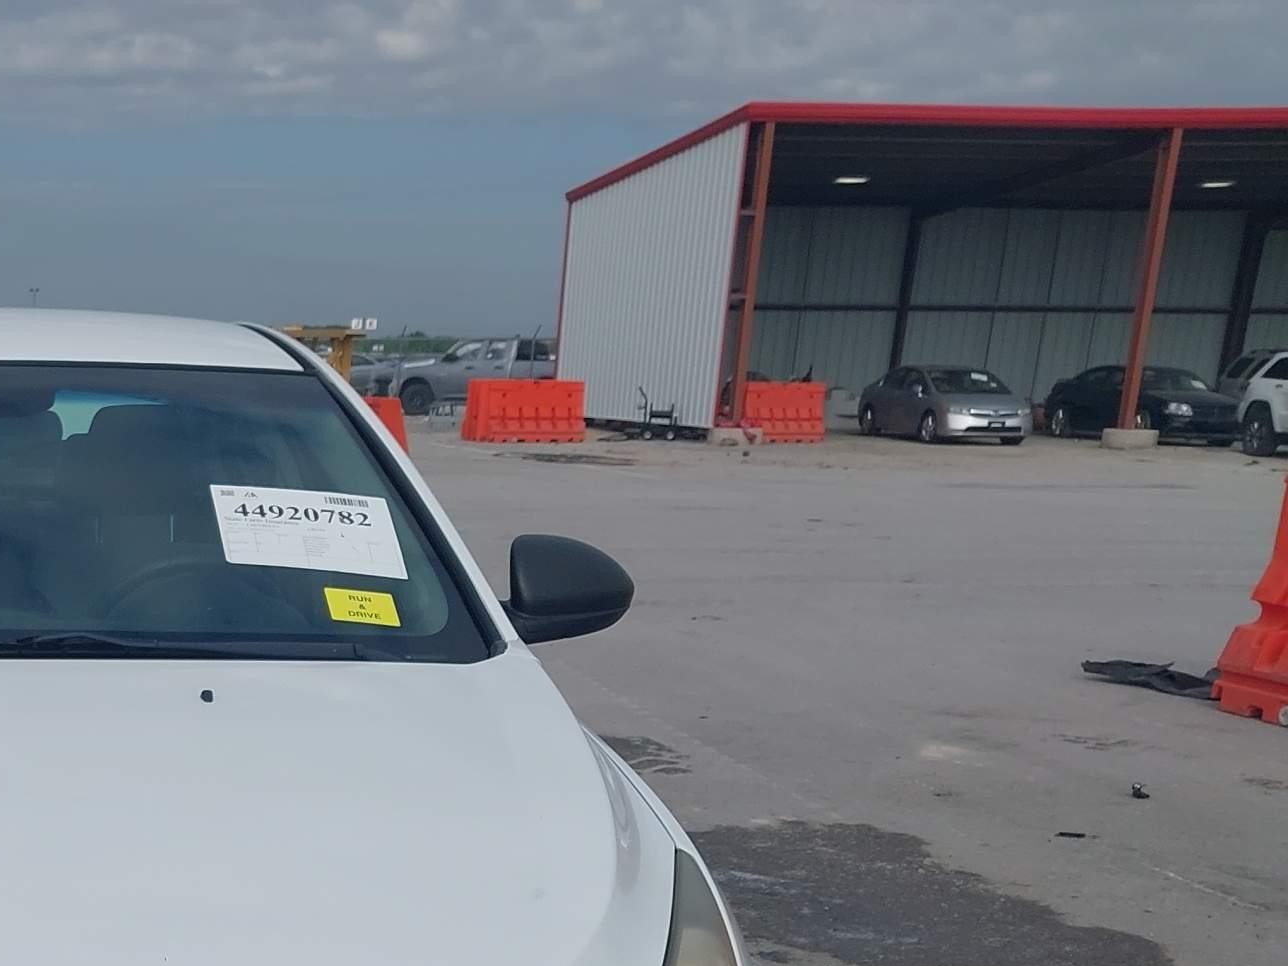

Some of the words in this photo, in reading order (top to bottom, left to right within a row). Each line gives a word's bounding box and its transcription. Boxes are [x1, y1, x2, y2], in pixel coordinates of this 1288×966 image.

[234, 503, 372, 527] 44920782
[348, 594, 372, 602] RUN
[348, 610, 382, 620] DRIVE
